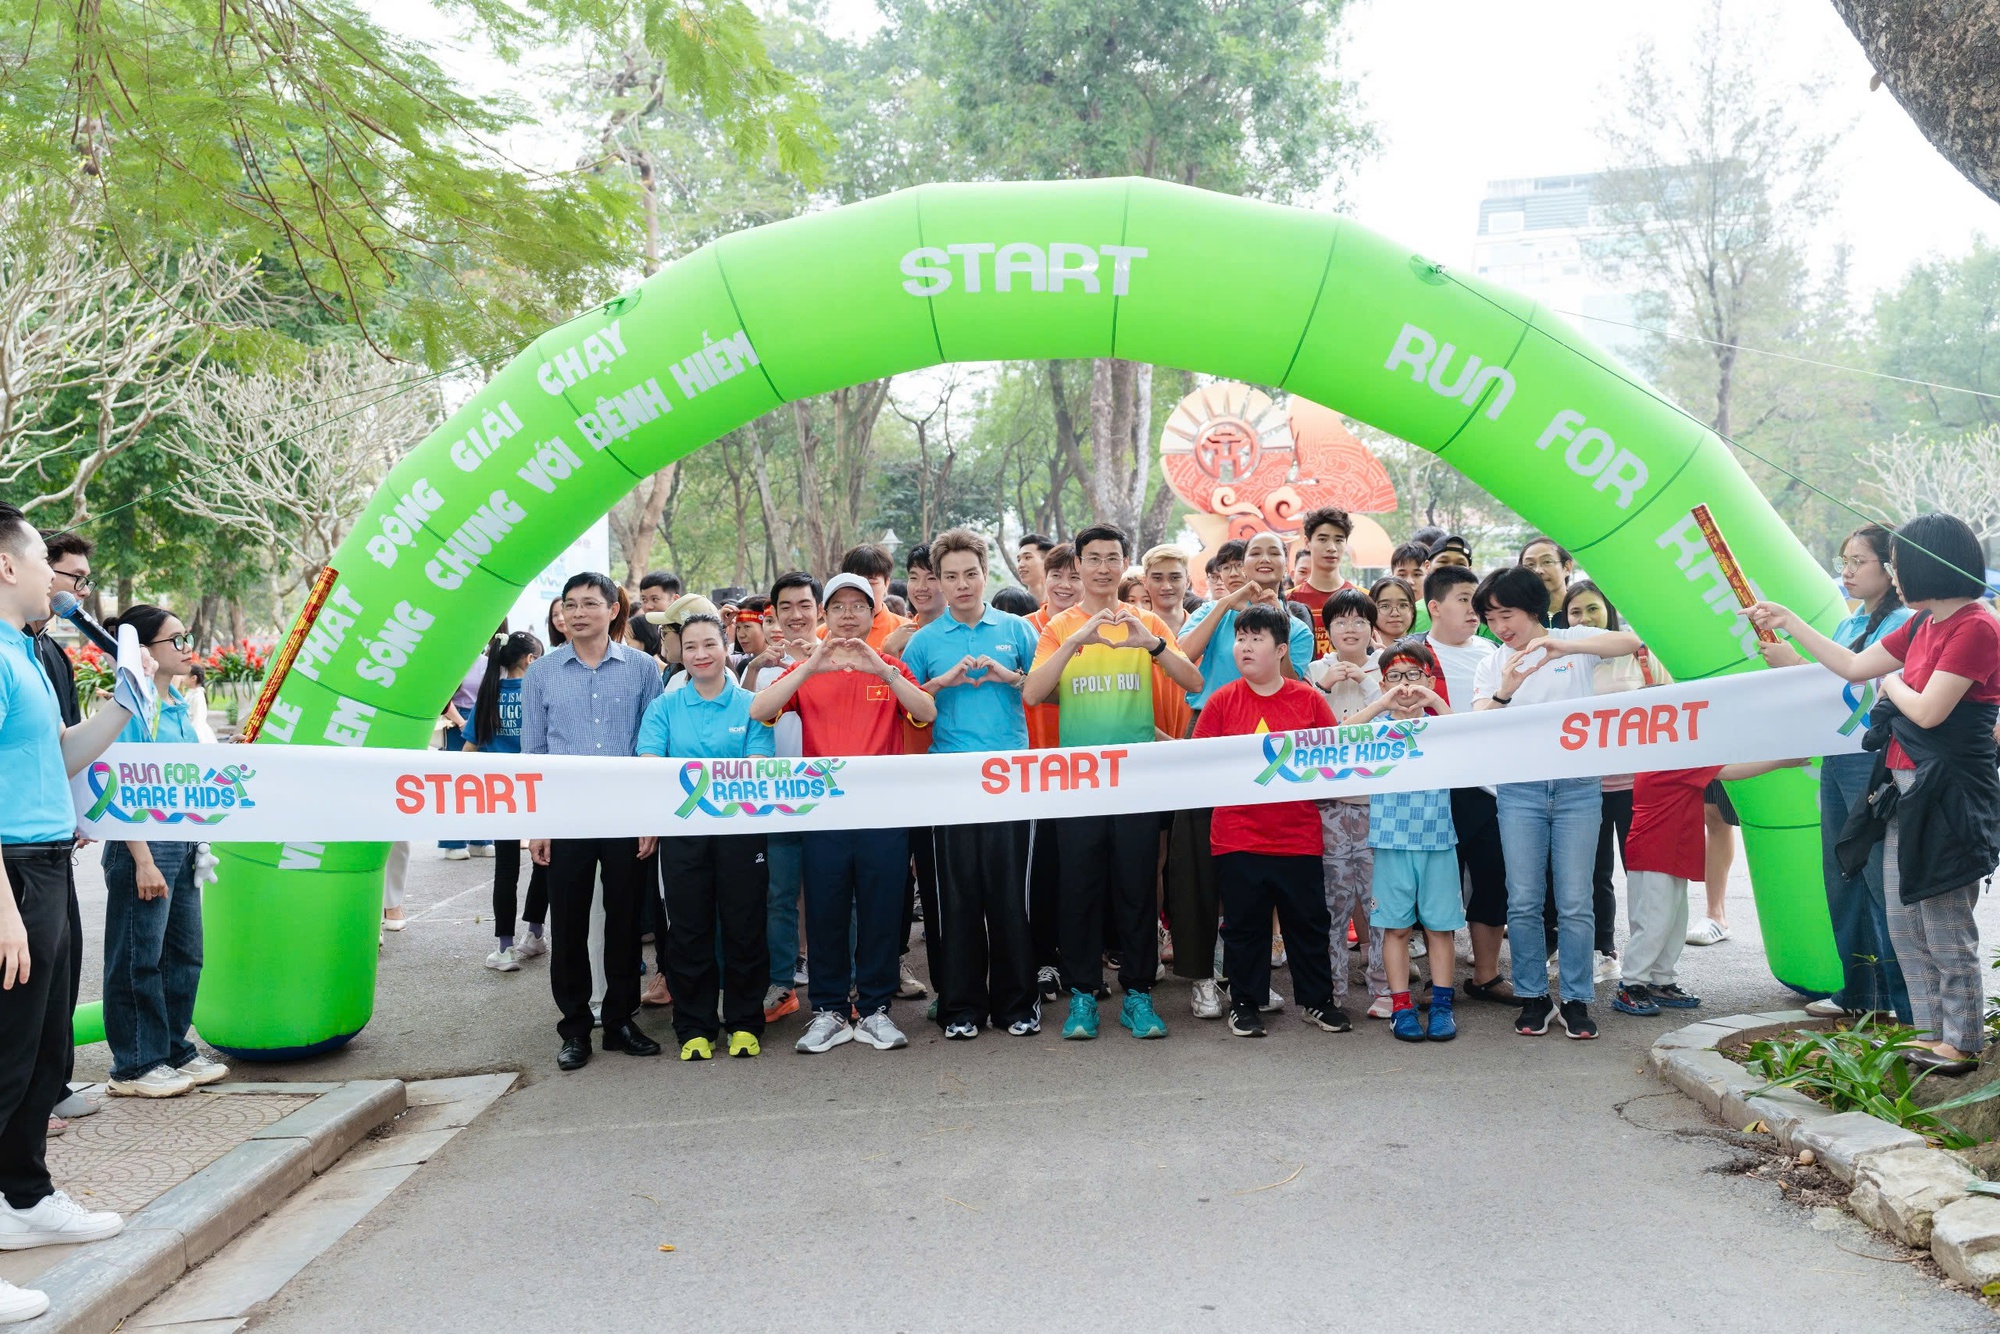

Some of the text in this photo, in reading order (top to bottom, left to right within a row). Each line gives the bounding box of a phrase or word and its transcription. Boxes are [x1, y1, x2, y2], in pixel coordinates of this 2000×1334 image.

[900, 242, 1148, 296] START
[1384, 322, 1516, 420] RUN
[1535, 409, 1649, 509] FOR
[366, 478, 444, 569] ĐỘNG
[450, 400, 524, 472] GIẢI
[537, 319, 627, 396] CHẠY
[323, 695, 377, 747] EM
[355, 600, 436, 688] SỐNG
[424, 489, 527, 590] CHUNG
[517, 435, 583, 494] VỚI
[574, 377, 673, 452] BỆNH
[669, 330, 760, 400] HIẾM
[1072, 673, 1140, 695] FPOLY RUN
[1294, 724, 1374, 747] RUN FOR
[1560, 701, 1709, 751] START
[712, 759, 791, 780] RUN FOR
[1294, 741, 1405, 767] RARE KIDS
[119, 763, 200, 784] RUN FOR
[981, 749, 1128, 794] START
[121, 786, 235, 808] RARE KIDS
[396, 773, 543, 814] START
[713, 778, 825, 800] RARE KIDS
